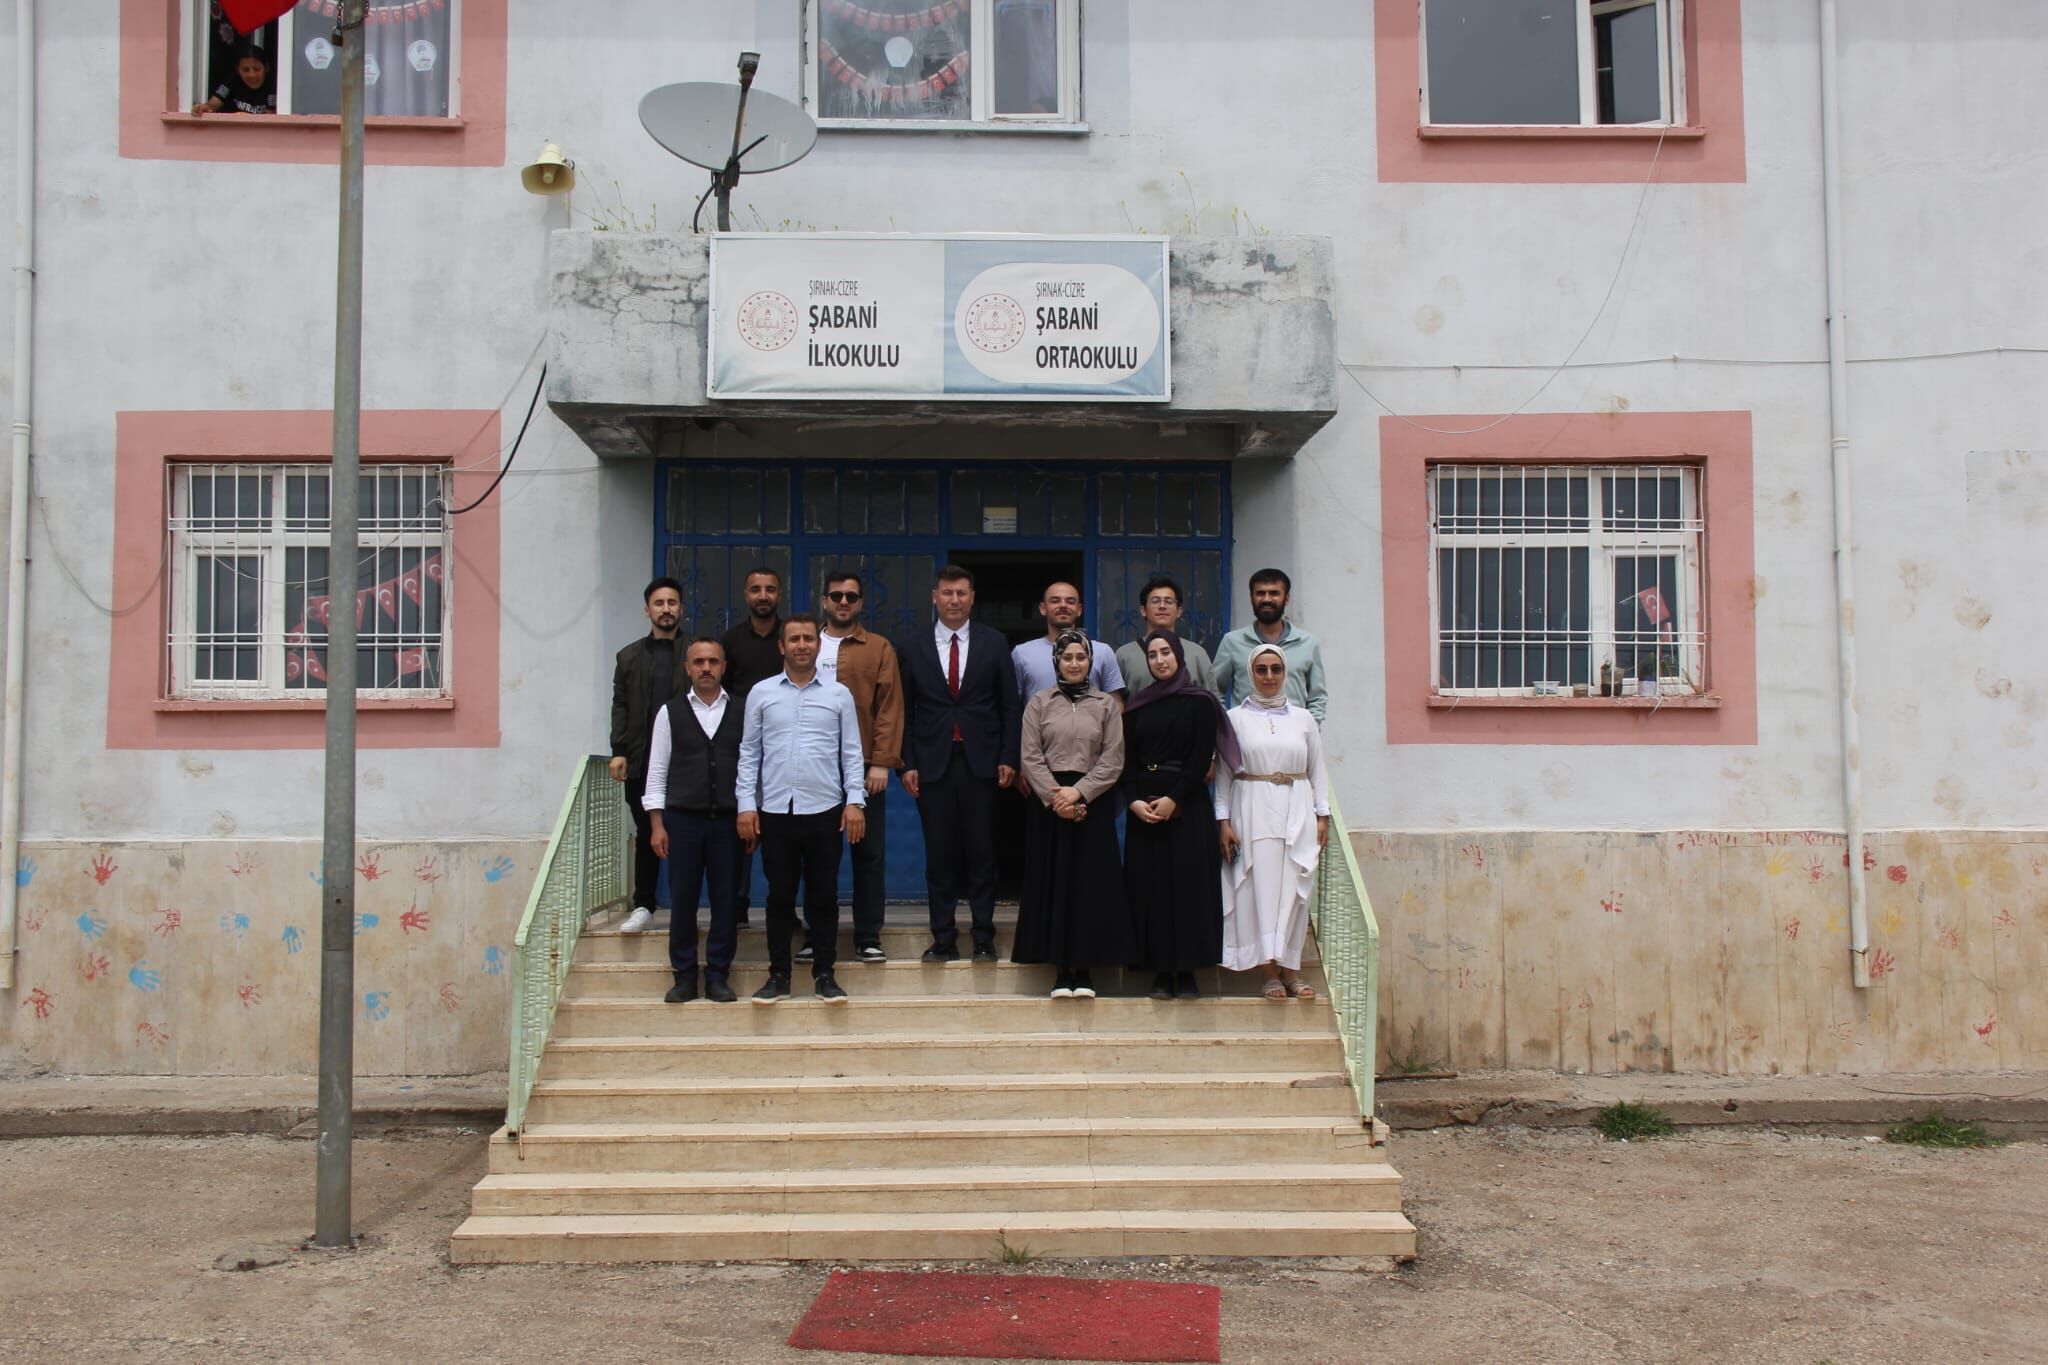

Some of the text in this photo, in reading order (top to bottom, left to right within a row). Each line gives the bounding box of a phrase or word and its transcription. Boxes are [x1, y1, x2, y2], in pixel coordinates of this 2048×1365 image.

[809, 300, 877, 334] ŞABANİ
[1036, 302, 1098, 336] ŞABANİ
[808, 338, 900, 367] İLKOKULU
[1036, 345, 1138, 369] ORTAOKULU
